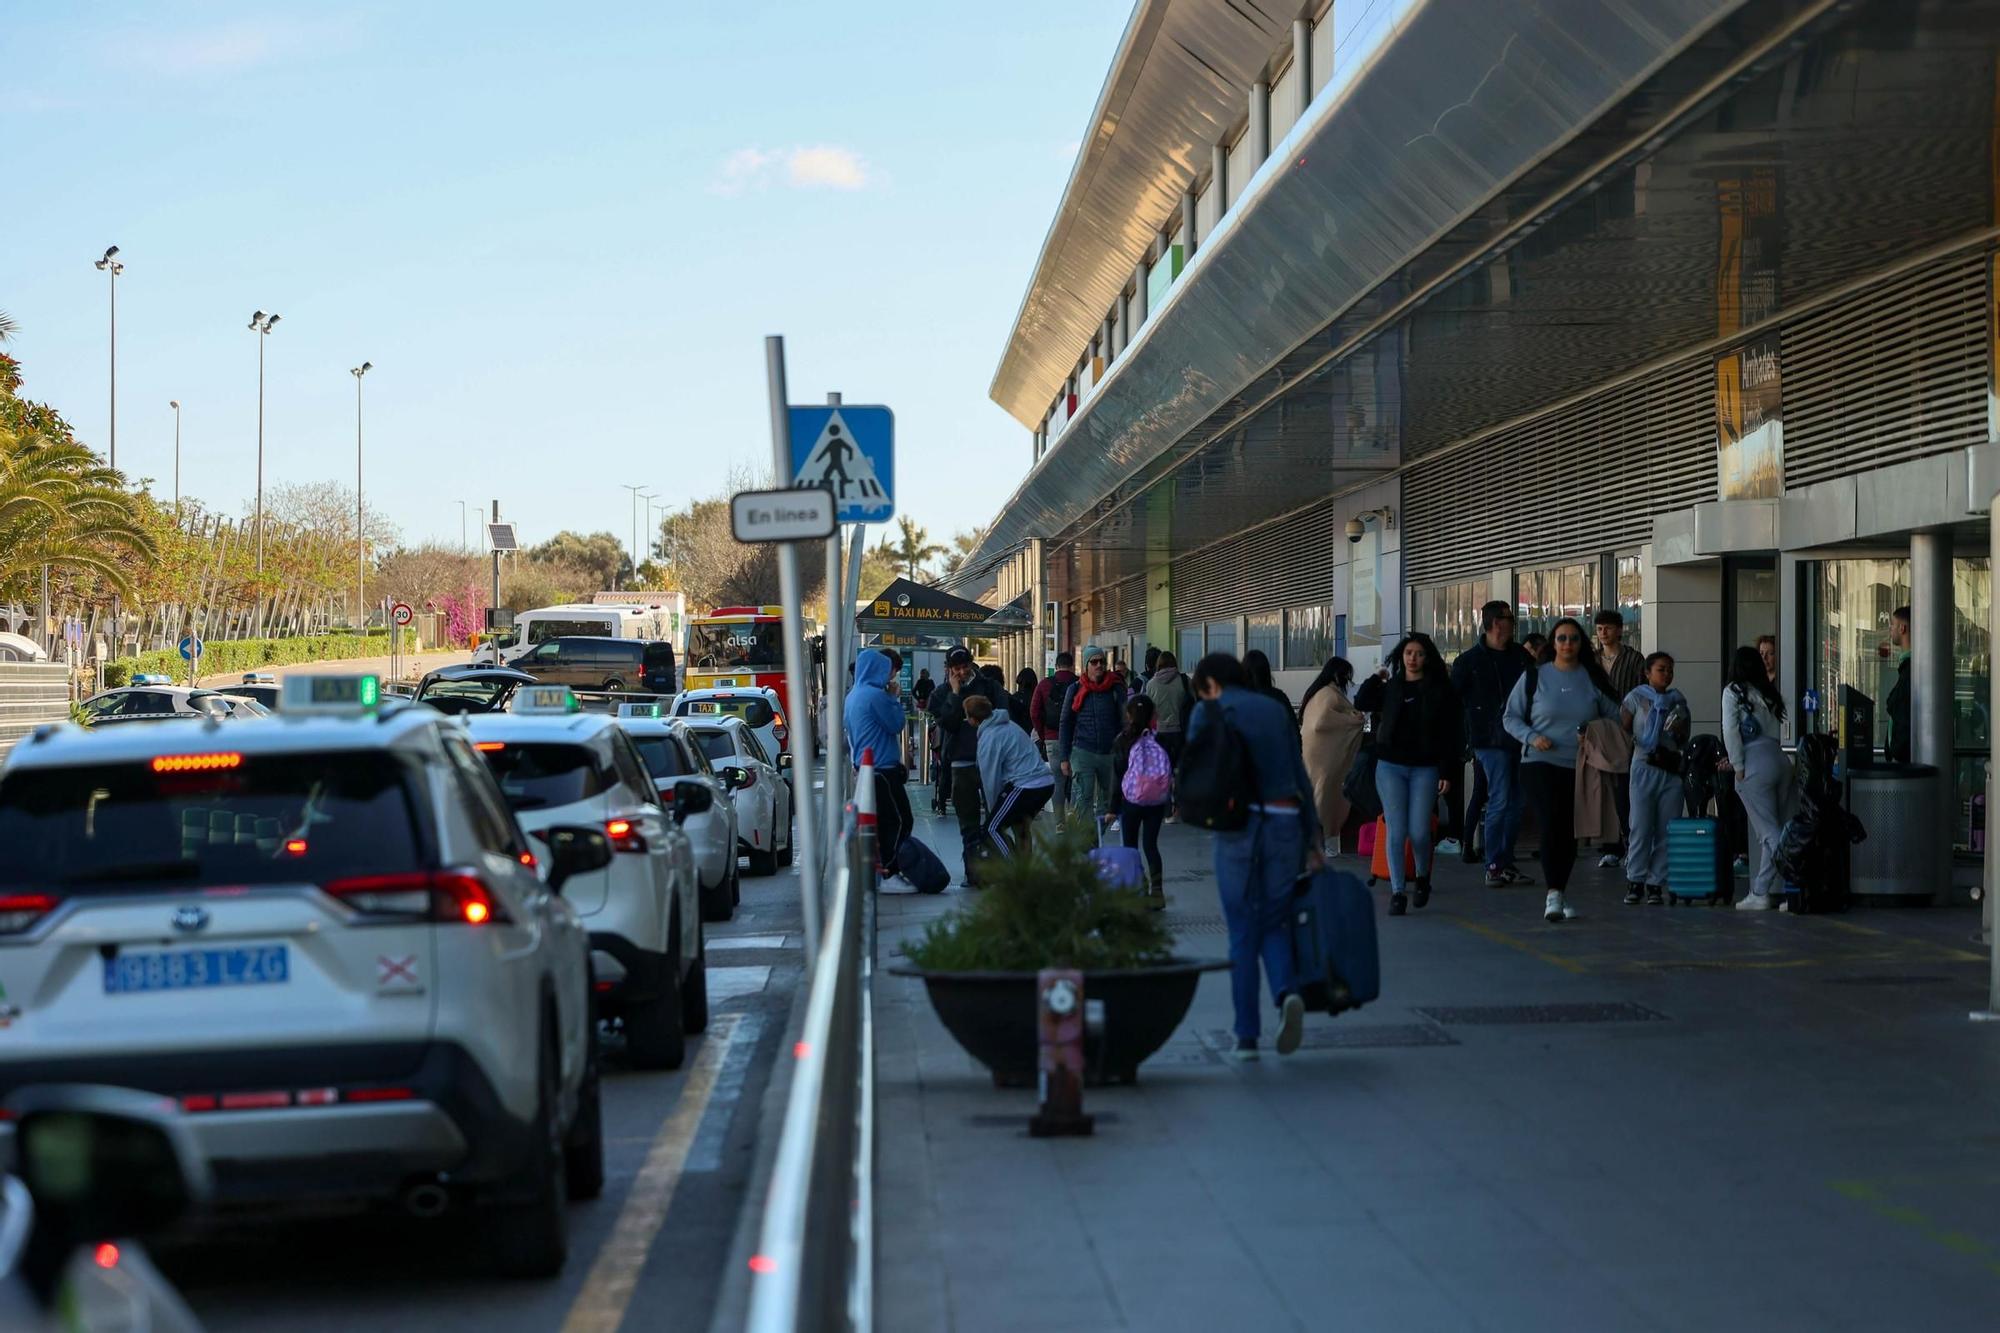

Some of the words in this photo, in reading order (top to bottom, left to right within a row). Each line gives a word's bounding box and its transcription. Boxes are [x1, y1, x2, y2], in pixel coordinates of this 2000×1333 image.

[1742, 344, 1775, 389] Arribades
[747, 509, 771, 526] En
[396, 610, 408, 619] 30
[893, 607, 914, 617] TAXI
[917, 608, 942, 619] MAX.
[944, 609, 950, 618] 4
[604, 622, 611, 630] 13
[727, 635, 757, 647] alsa
[897, 635, 916, 645] BUS
[535, 691, 563, 705] TAXI
